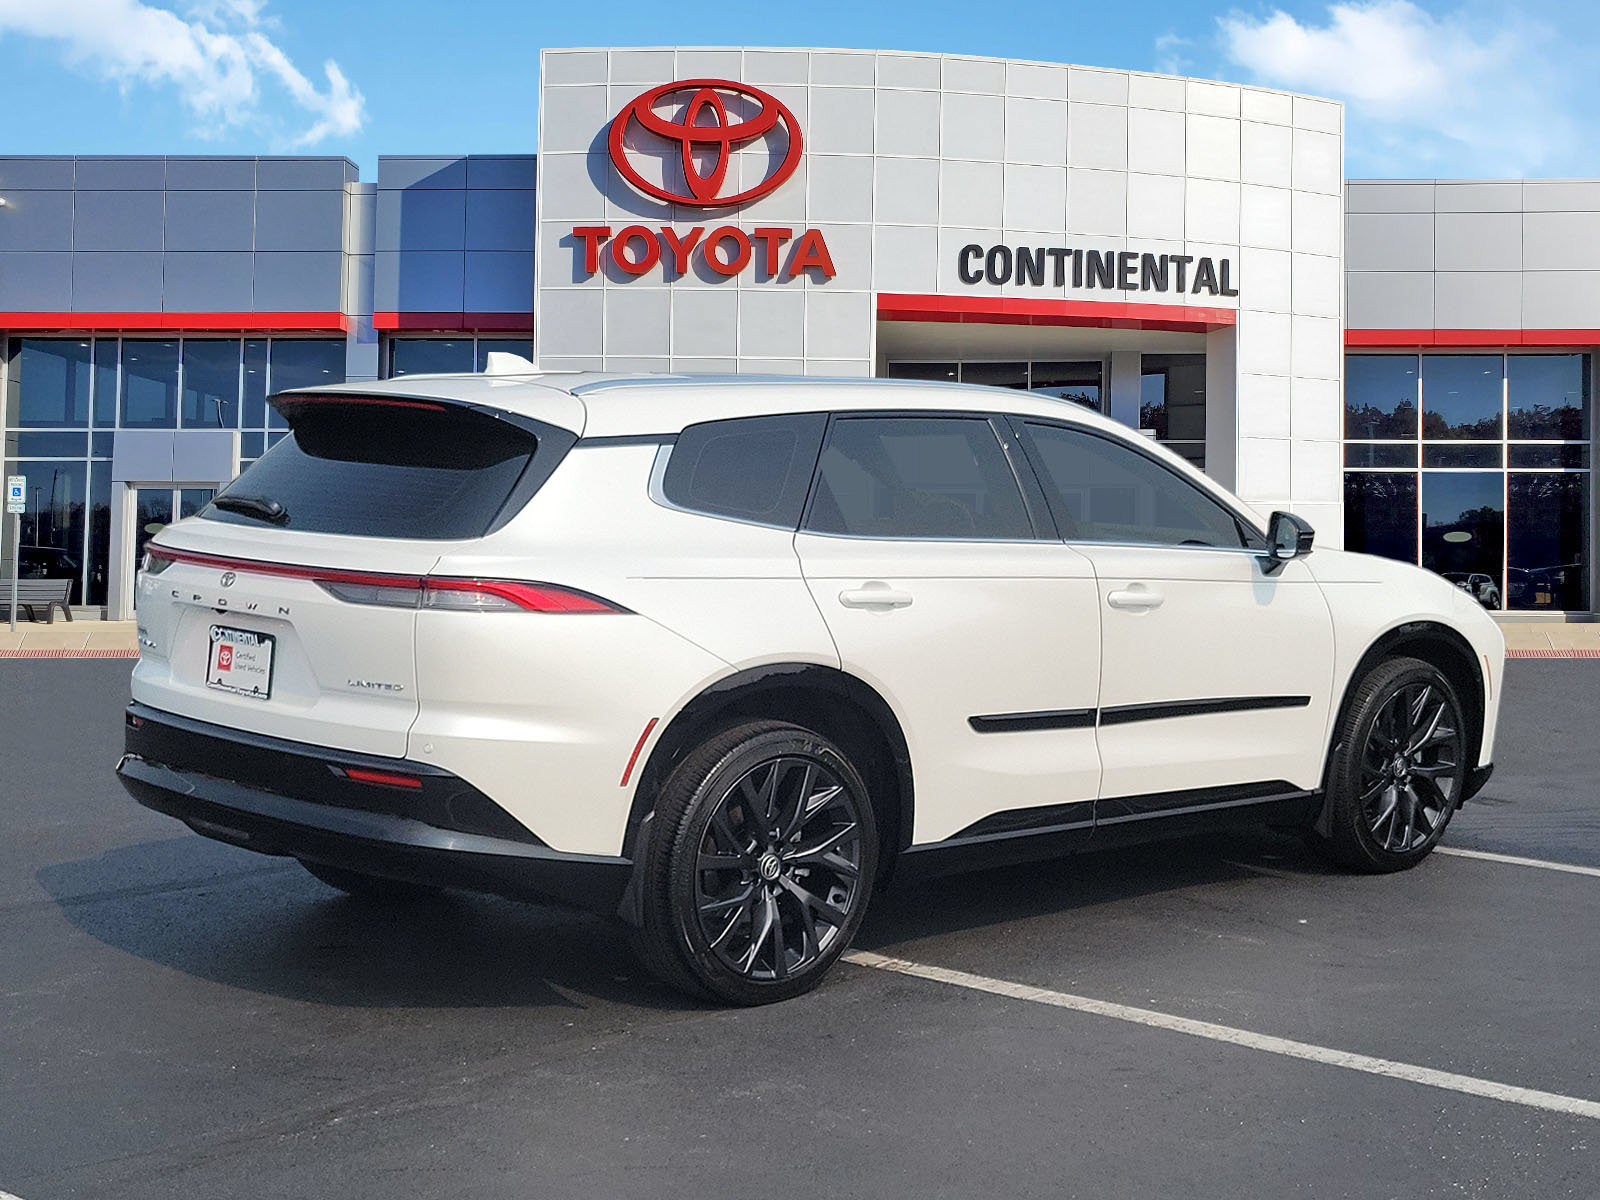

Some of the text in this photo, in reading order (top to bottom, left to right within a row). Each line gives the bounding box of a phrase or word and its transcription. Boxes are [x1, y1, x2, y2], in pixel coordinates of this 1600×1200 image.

[572, 225, 836, 276] TOYOTA
[959, 244, 1239, 296] CONTINENTAL
[171, 590, 290, 615] CROWN
[347, 680, 404, 691] LIMITED
